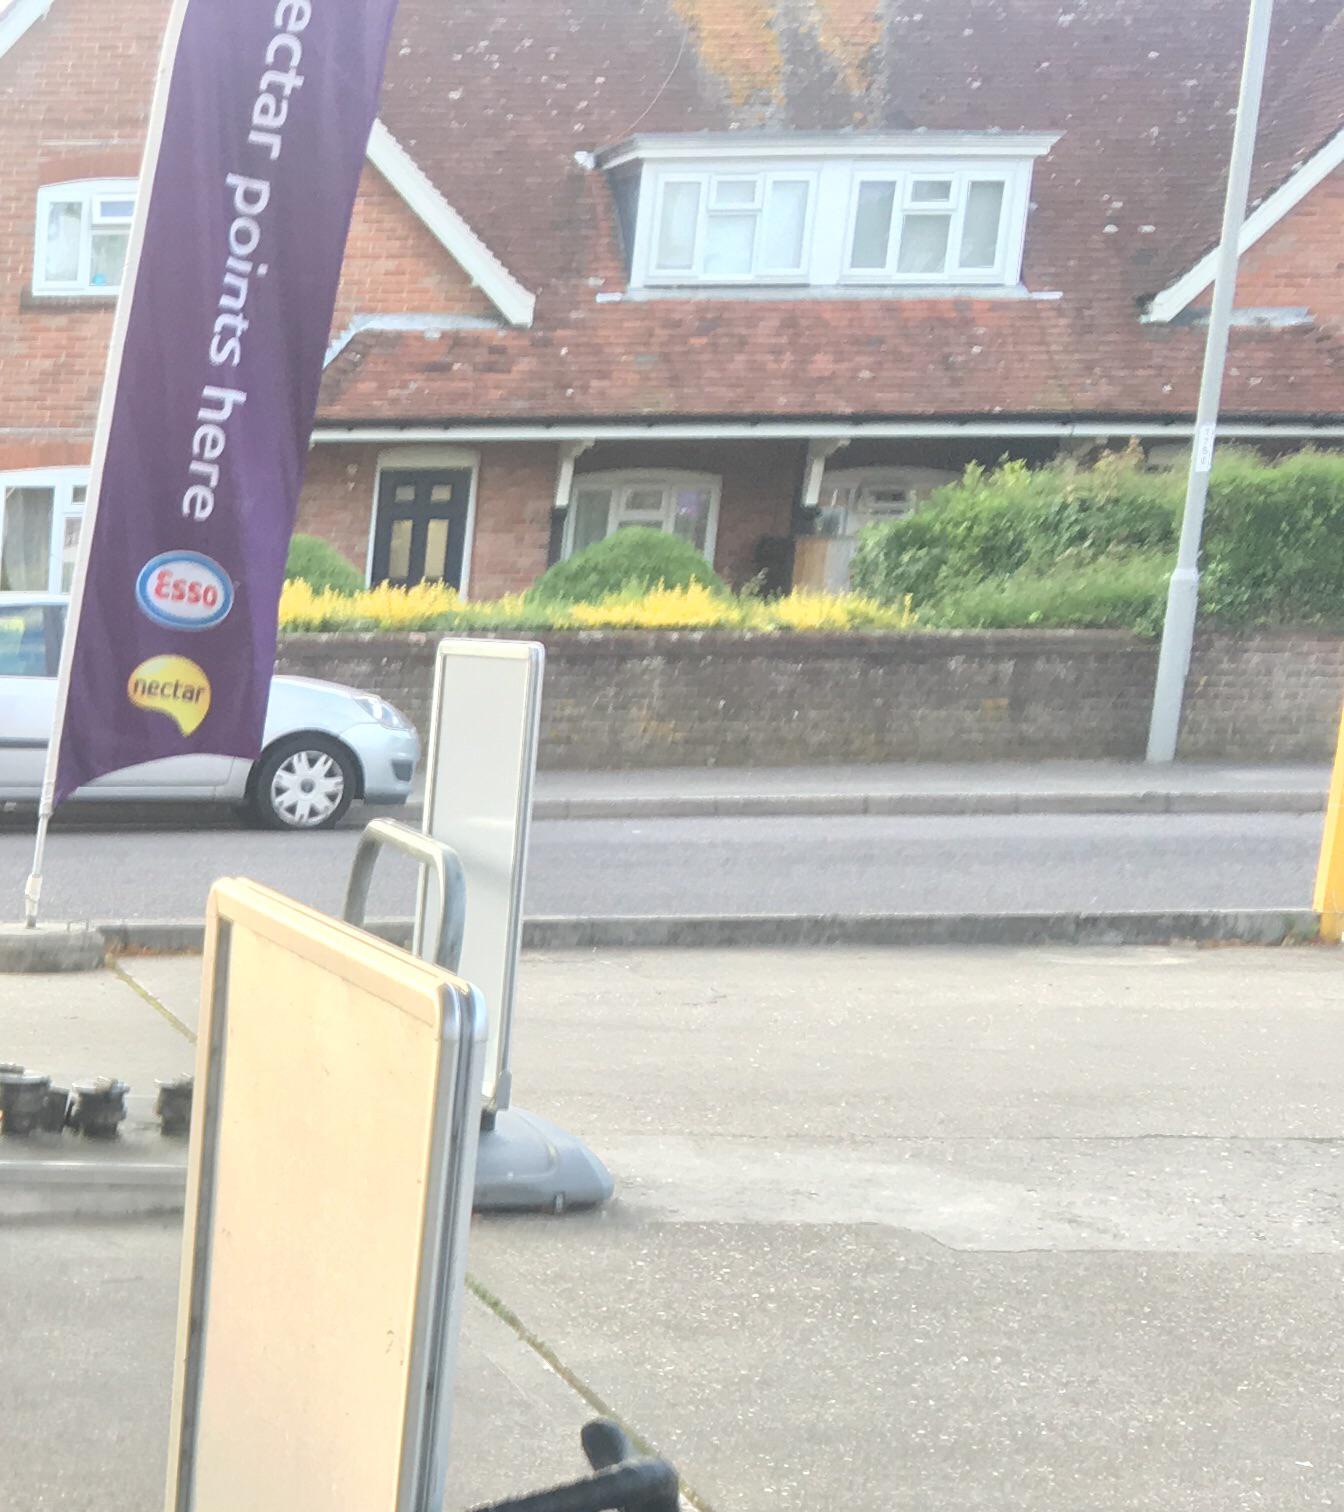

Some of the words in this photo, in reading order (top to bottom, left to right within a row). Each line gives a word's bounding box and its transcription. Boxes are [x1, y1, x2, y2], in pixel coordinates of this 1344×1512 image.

[210, 173, 270, 367] points
[182, 385, 247, 522] here
[154, 570, 218, 608] Esso
[132, 676, 206, 705] nectar
